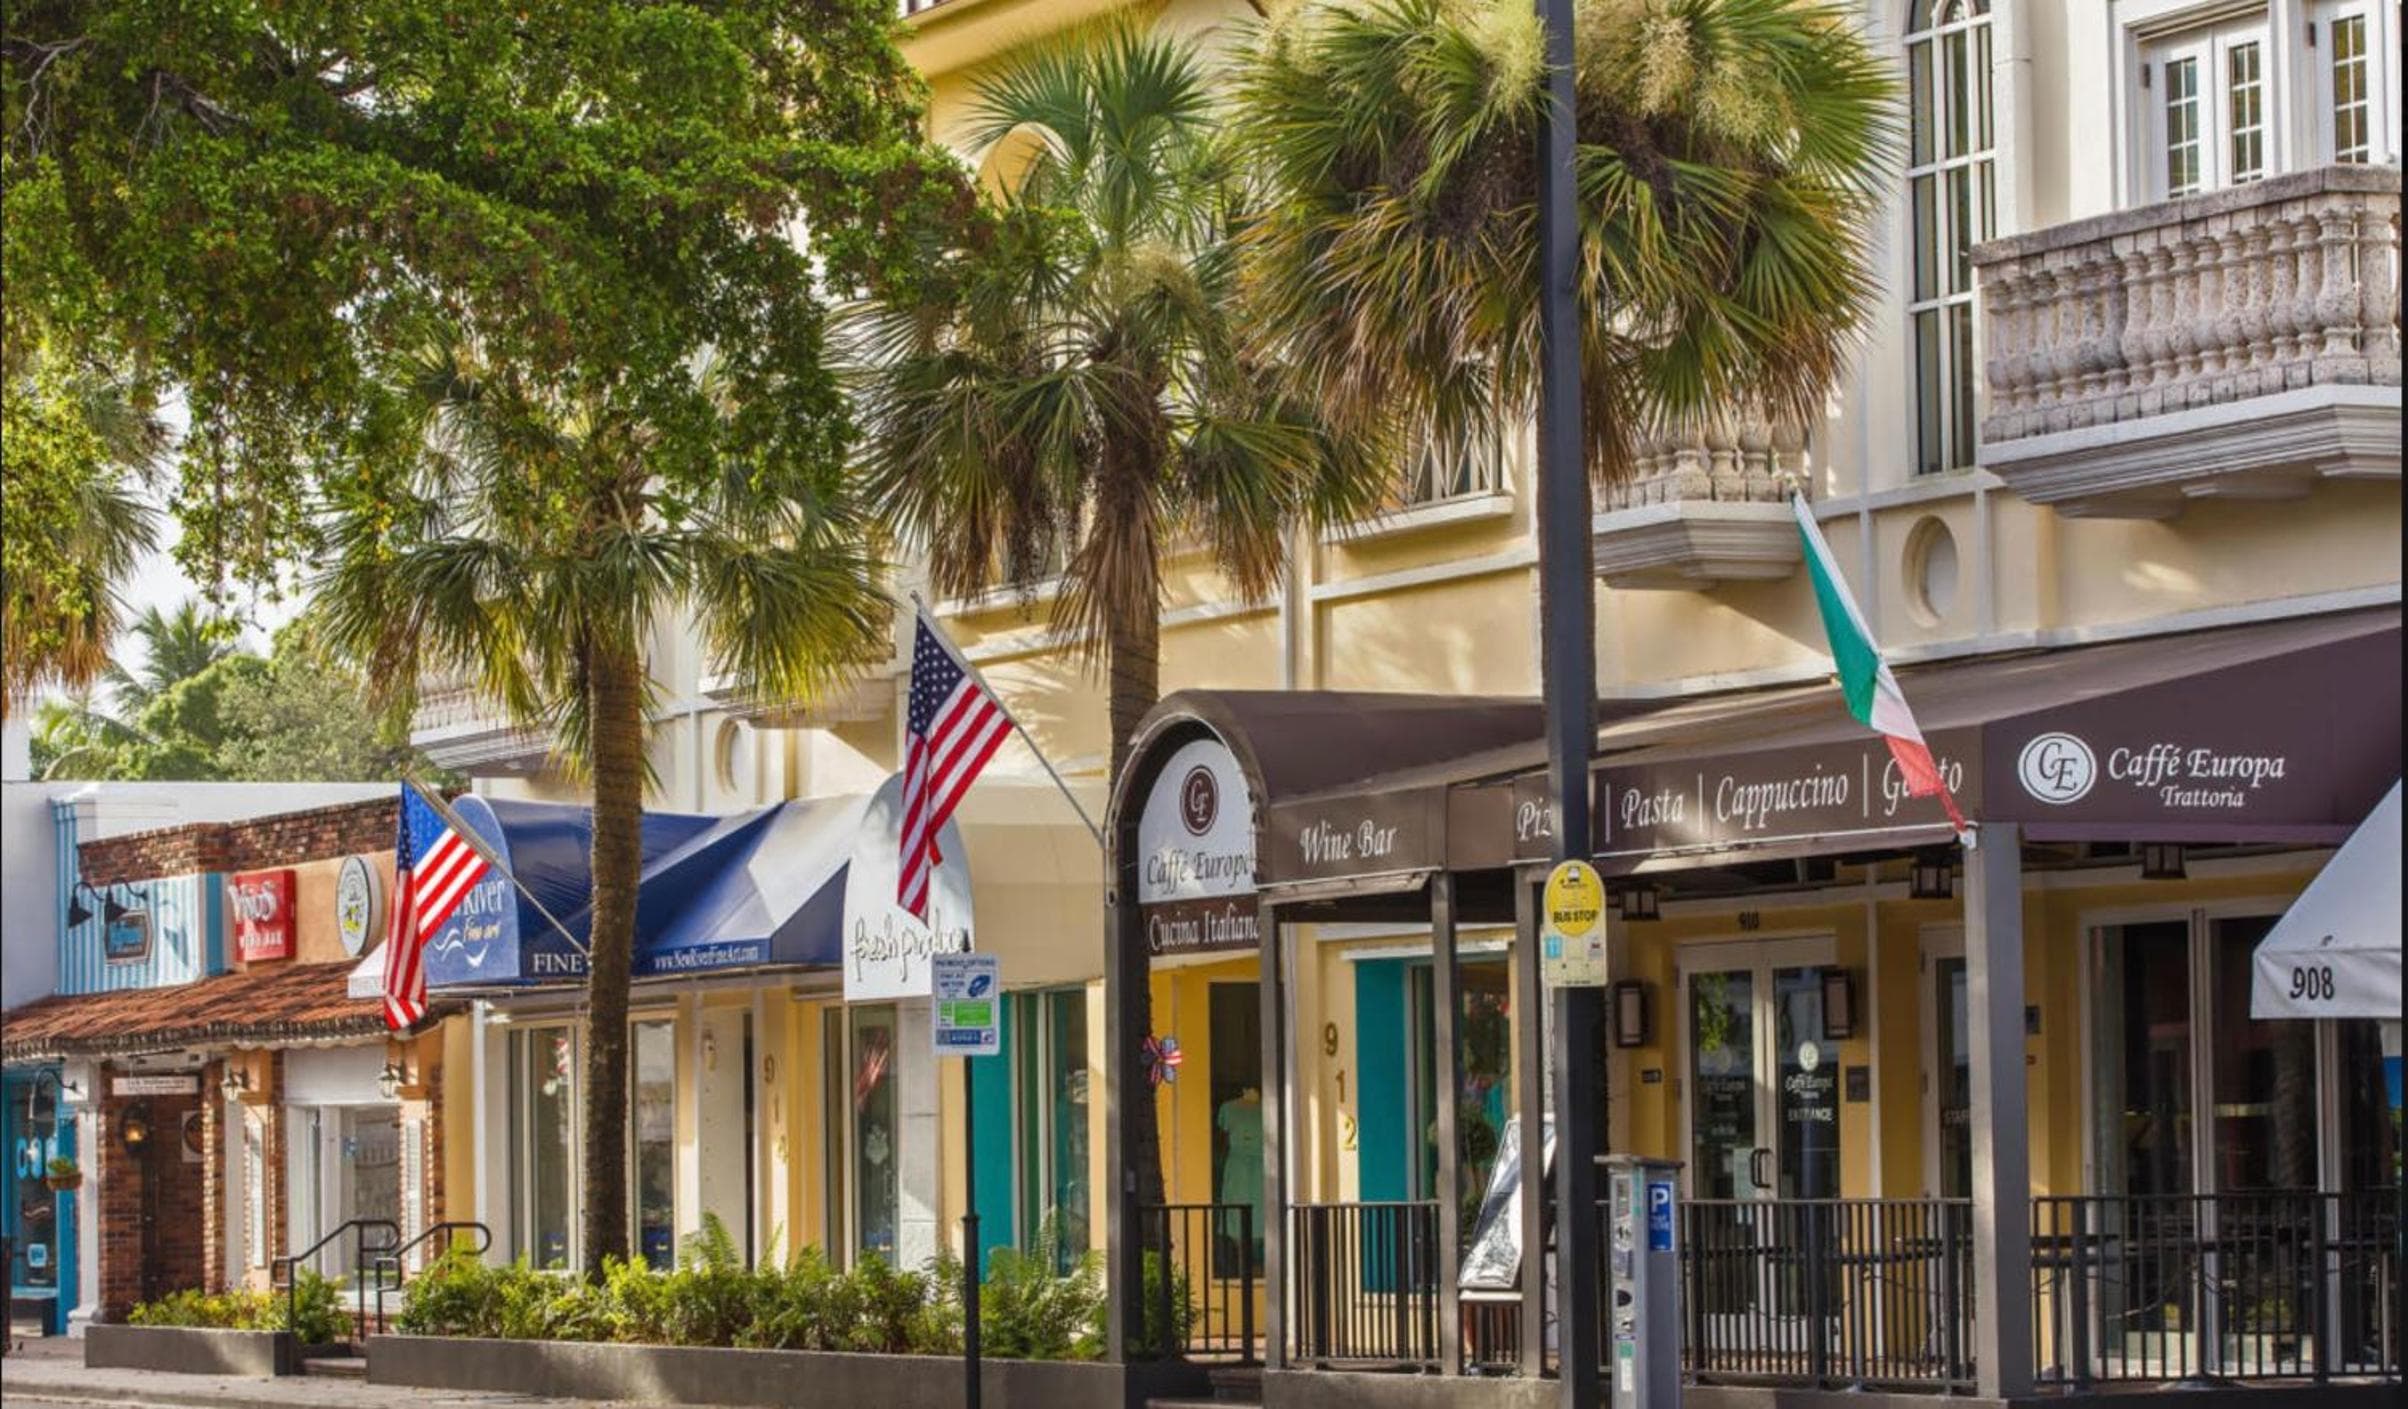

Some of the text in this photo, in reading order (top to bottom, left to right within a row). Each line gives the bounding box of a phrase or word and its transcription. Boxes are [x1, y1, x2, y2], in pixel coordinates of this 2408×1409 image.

[2108, 744, 2286, 788] Caffé Europa
[1621, 788, 1686, 830] Pasta
[1716, 763, 1849, 831] Cappuccino
[2160, 784, 2244, 807] Trattoria
[1299, 819, 1398, 865] Wine Bar
[1149, 910, 1200, 951] Cucina
[1553, 909, 1599, 923] BUS STOP
[532, 952, 583, 974] FINE
[2289, 966, 2335, 1000] 908
[1651, 1187, 1669, 1212] P
